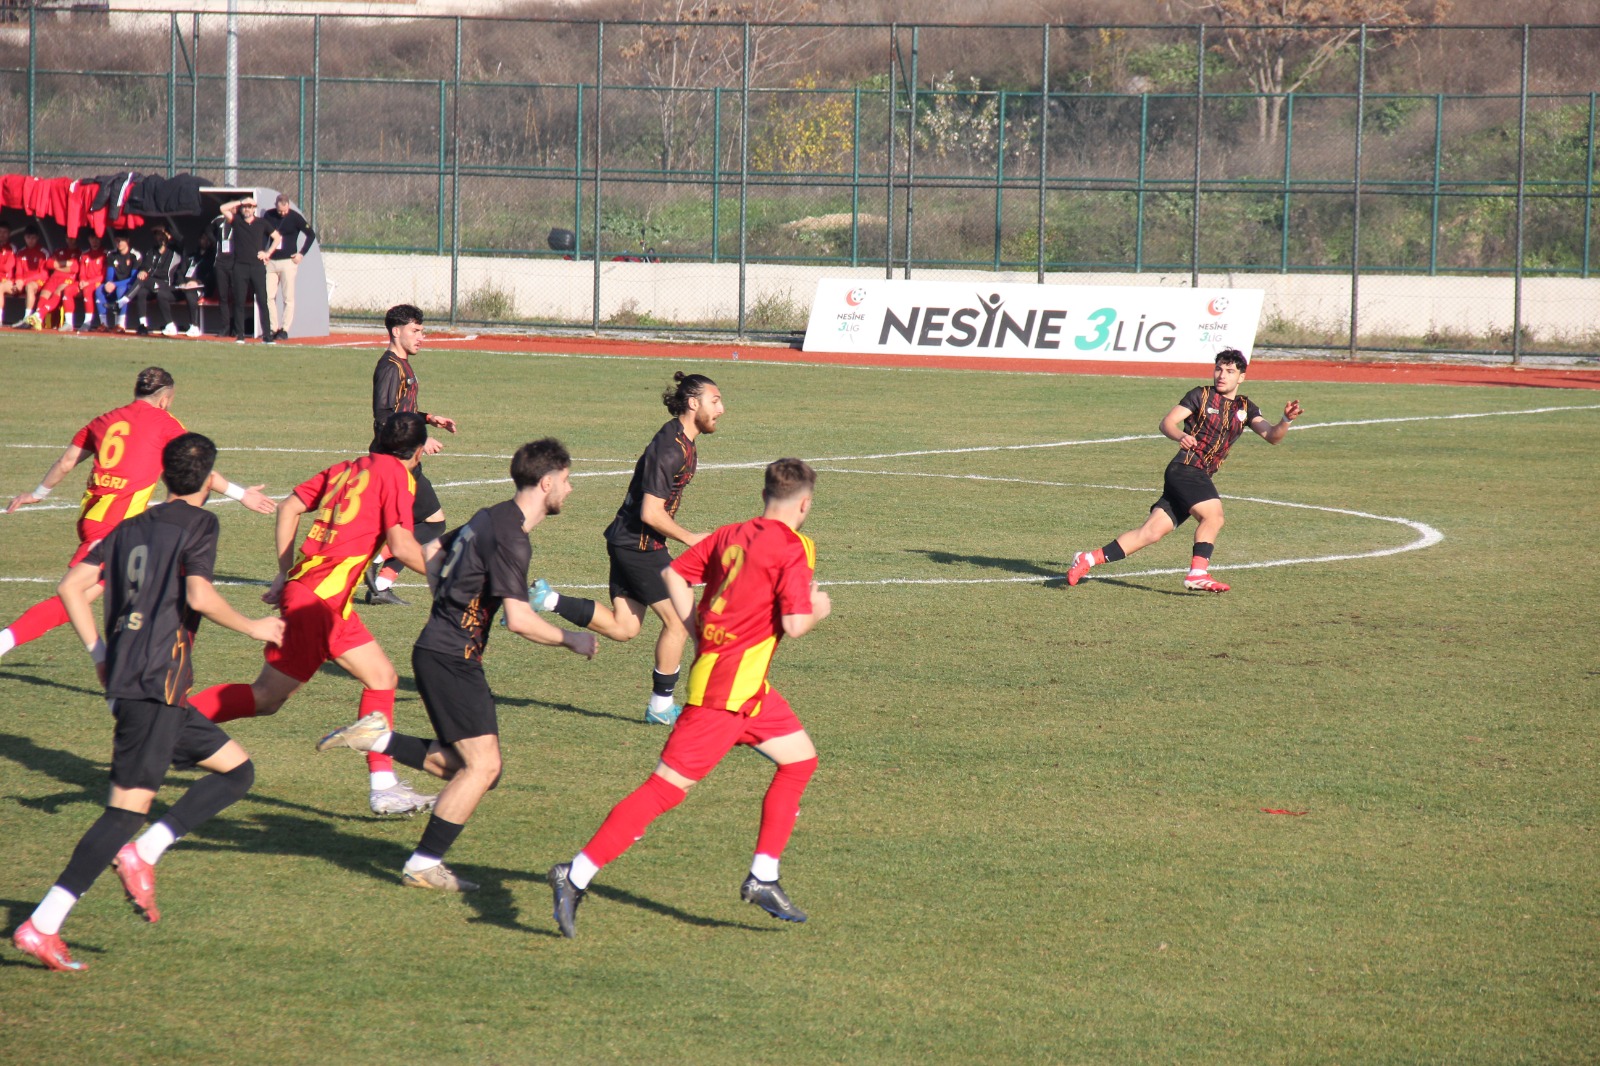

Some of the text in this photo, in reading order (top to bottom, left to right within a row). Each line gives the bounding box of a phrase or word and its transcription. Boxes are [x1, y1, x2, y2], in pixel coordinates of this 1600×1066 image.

[878, 292, 1067, 349] NESİNE
[99, 421, 129, 469] 6
[317, 467, 370, 525] 23
[127, 544, 148, 604] 9
[710, 544, 744, 616] 2
